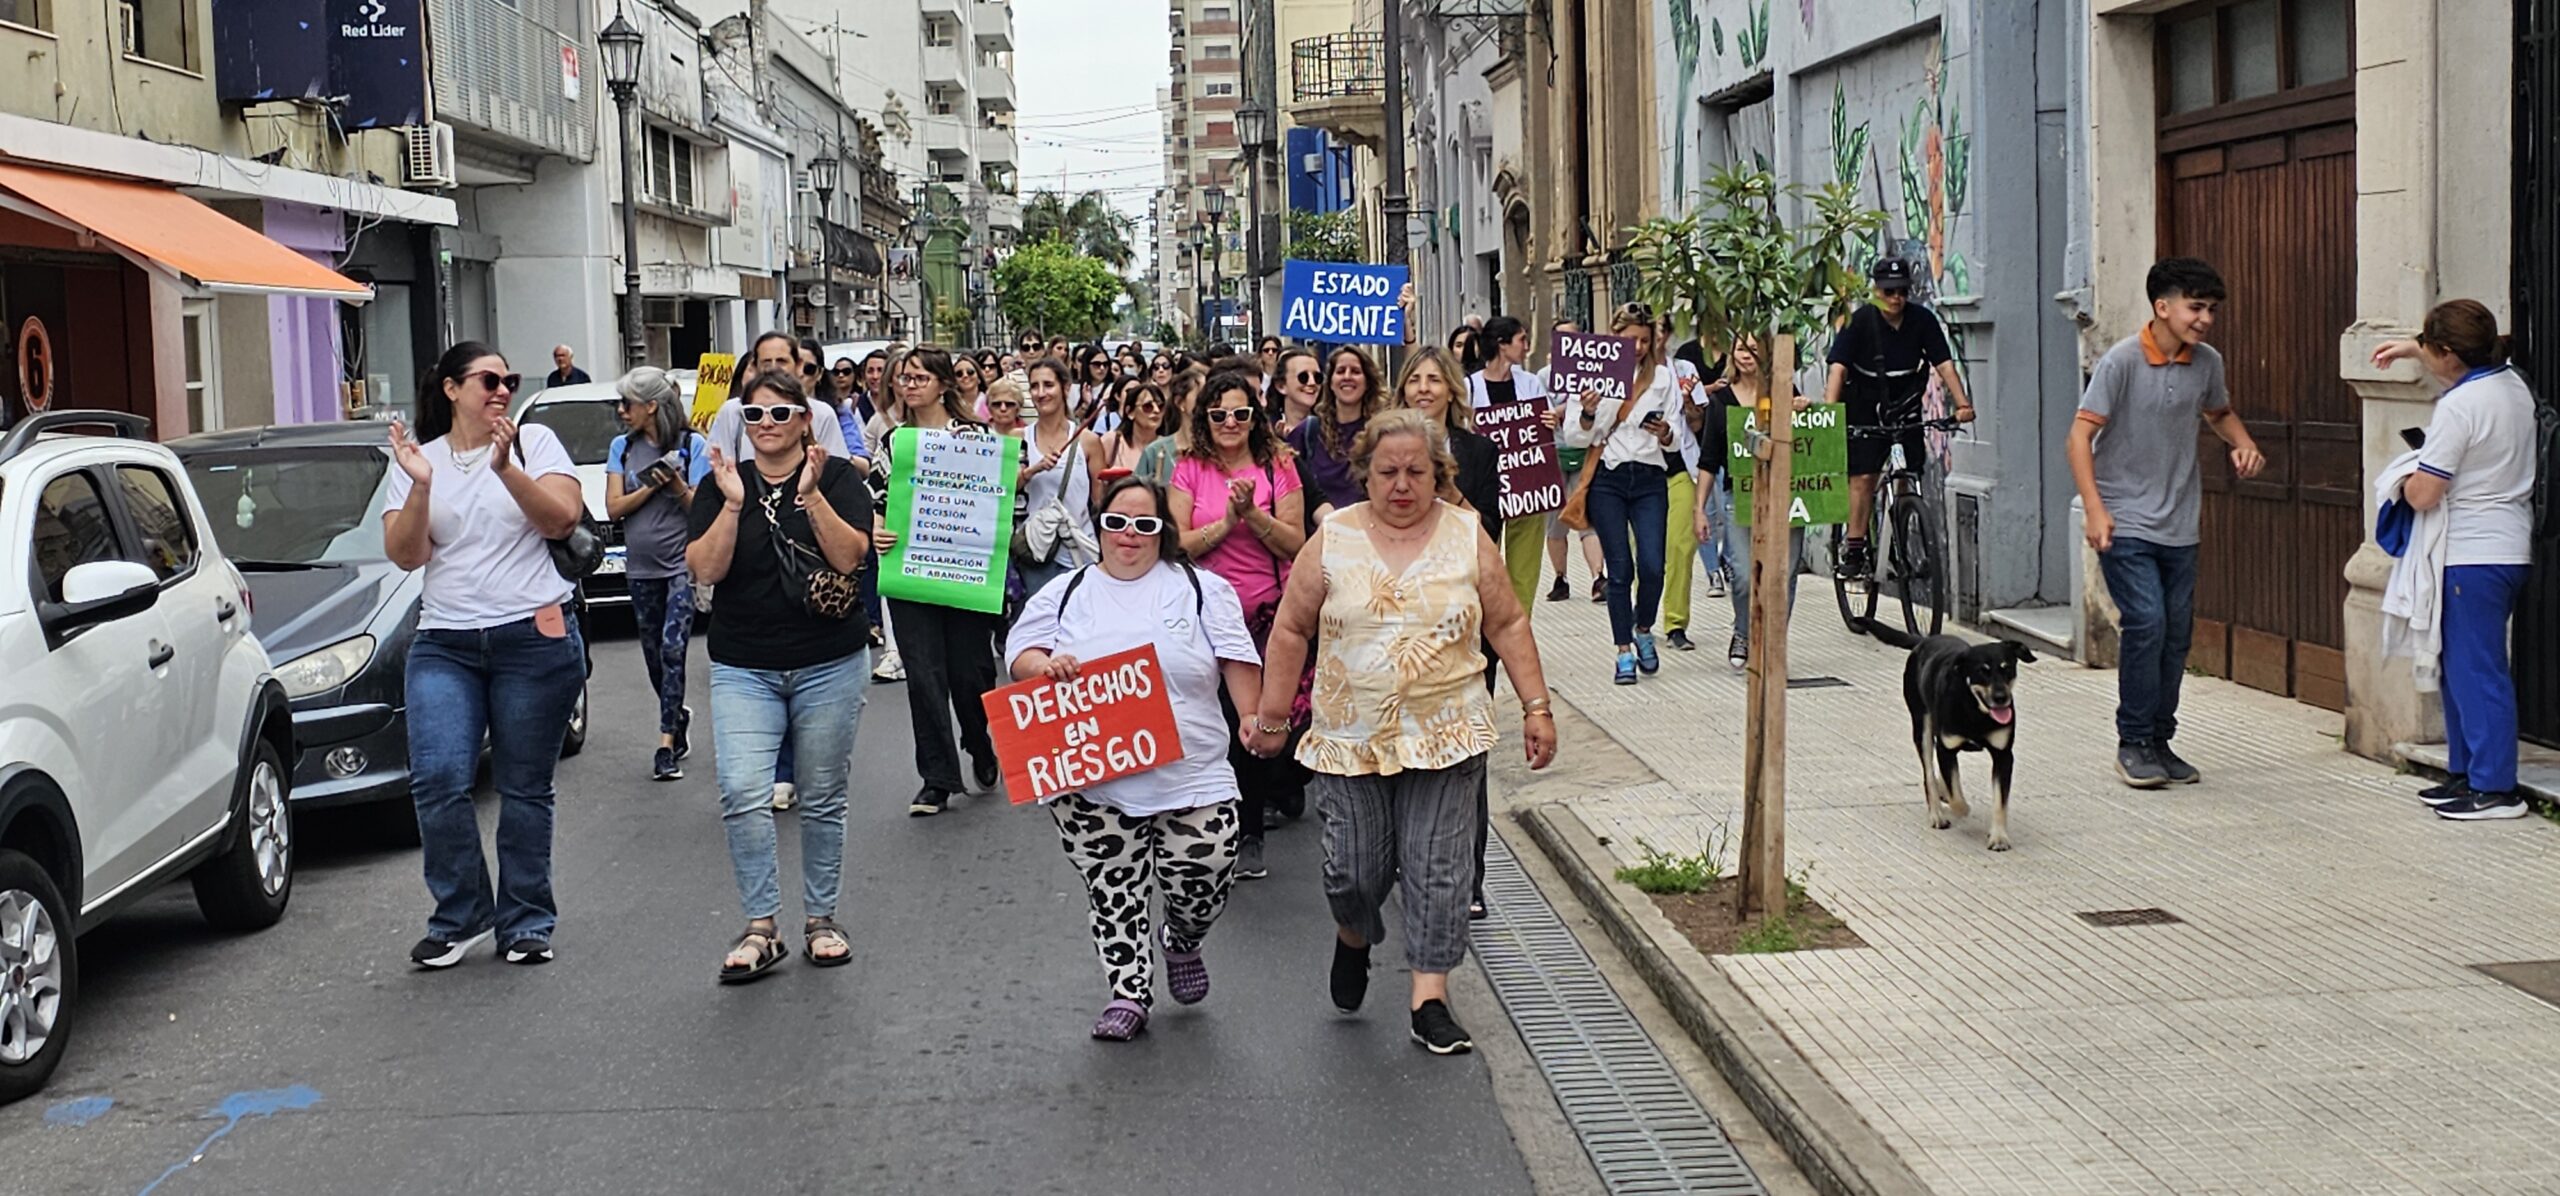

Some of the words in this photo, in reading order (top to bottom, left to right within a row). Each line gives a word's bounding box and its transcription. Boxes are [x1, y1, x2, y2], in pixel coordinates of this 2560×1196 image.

[341, 24, 368, 37] Red
[371, 24, 406, 37] Lider
[1312, 271, 1390, 296] ESTADO
[1286, 297, 1399, 336] AUSENTE
[1561, 336, 1622, 361] PAGOS
[26, 334, 45, 400] 6
[1577, 361, 1603, 373] CON
[1554, 373, 1626, 398] DEMORA
[1518, 425, 1538, 444] DE
[925, 442, 946, 452] CON
[955, 446, 967, 454] LA
[976, 448, 995, 457] LEY
[923, 456, 937, 464] DE
[928, 479, 1003, 494] DISCAPACIDAD
[920, 494, 935, 503] NO
[938, 496, 950, 505] ES
[954, 498, 976, 508] UNA
[1498, 484, 1561, 519] NDONO
[916, 533, 928, 541] ES
[931, 535, 953, 545] UNA
[904, 566, 918, 575] DE
[926, 569, 984, 583] ABANDONO
[1008, 658, 1152, 730] DERECHOS
[1064, 716, 1100, 747] EN
